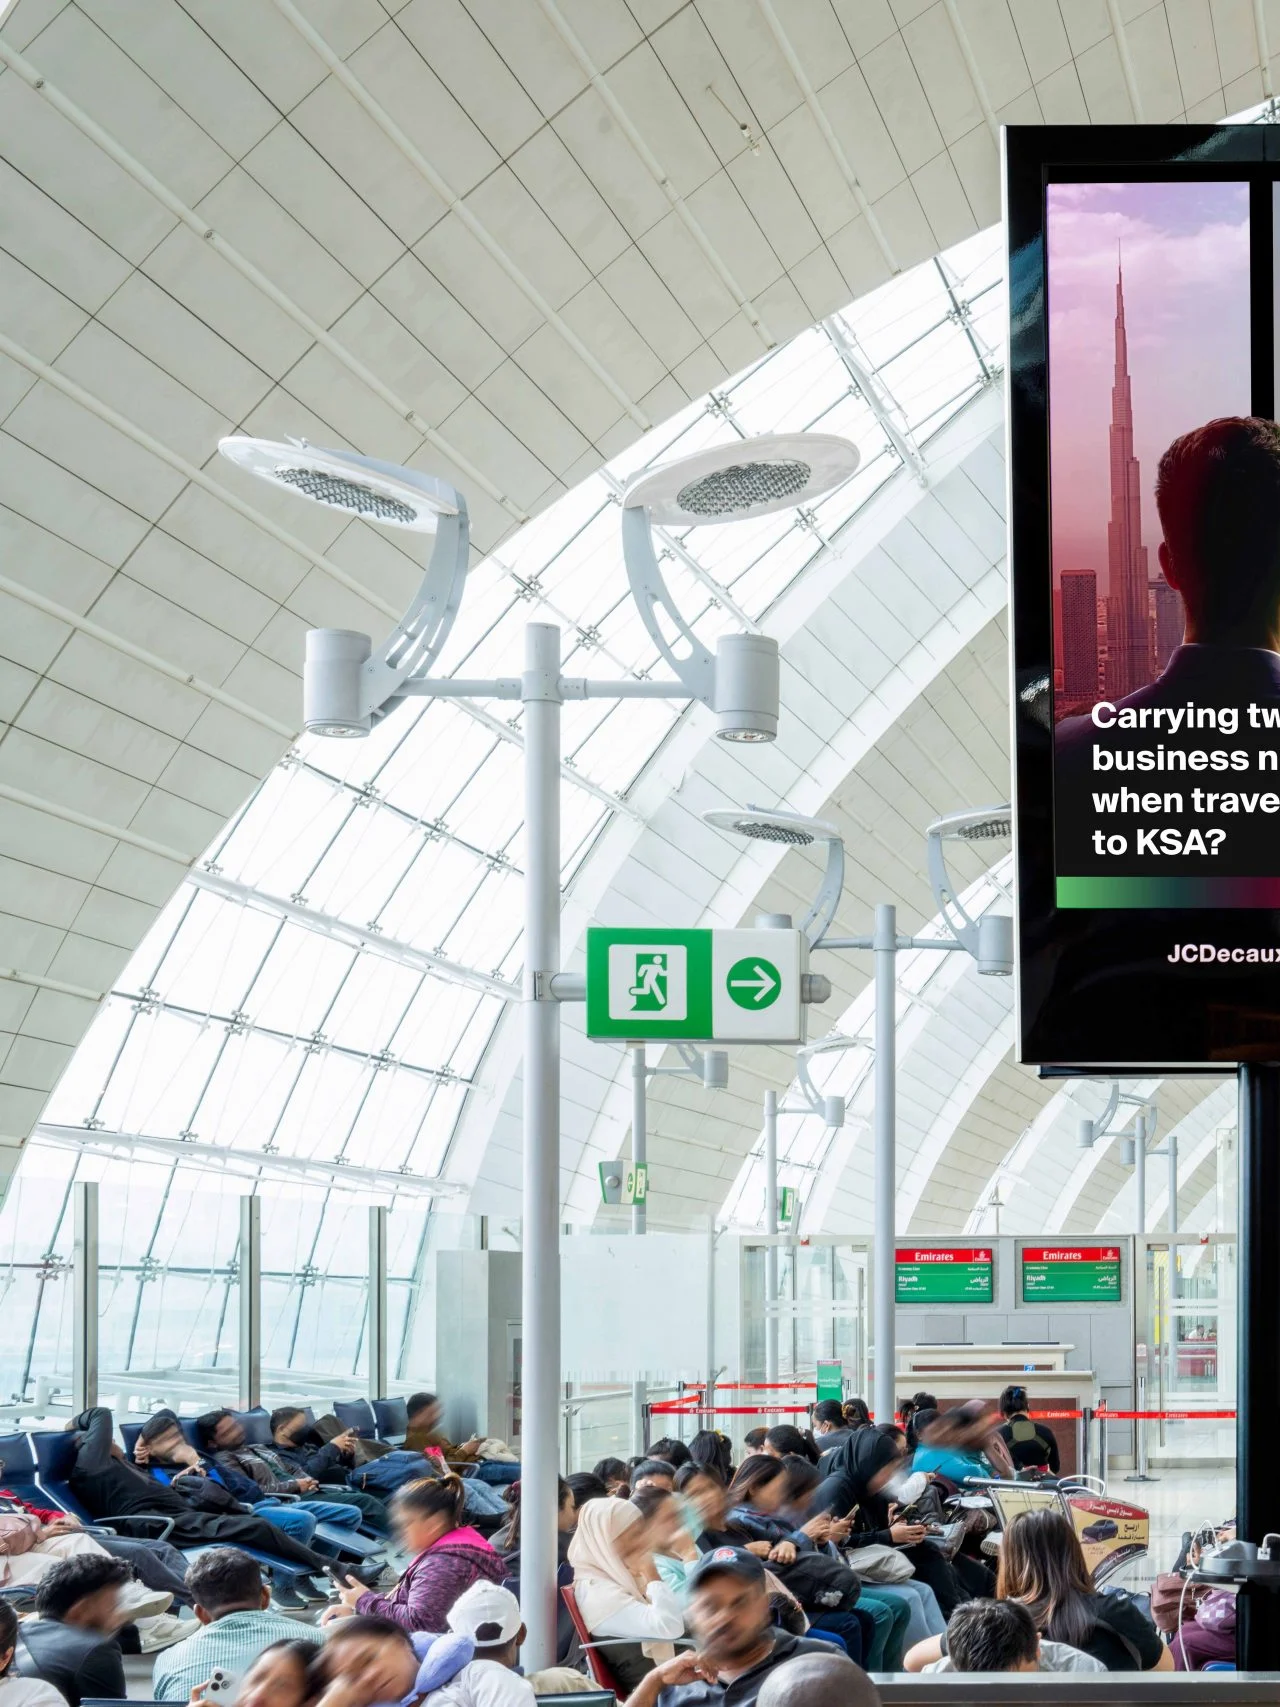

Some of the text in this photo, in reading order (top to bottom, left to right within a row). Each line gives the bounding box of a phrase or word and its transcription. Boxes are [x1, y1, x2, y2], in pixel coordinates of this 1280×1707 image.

[1091, 702, 1239, 733] Carrying
[1092, 744, 1249, 771] business
[1092, 786, 1183, 813] when
[1092, 828, 1226, 856] to KSA?
[915, 1252, 954, 1261] Emirates
[1043, 1251, 1082, 1260] Emirates
[898, 1276, 918, 1284] Riyadh
[1026, 1274, 1046, 1282] Riyadh
